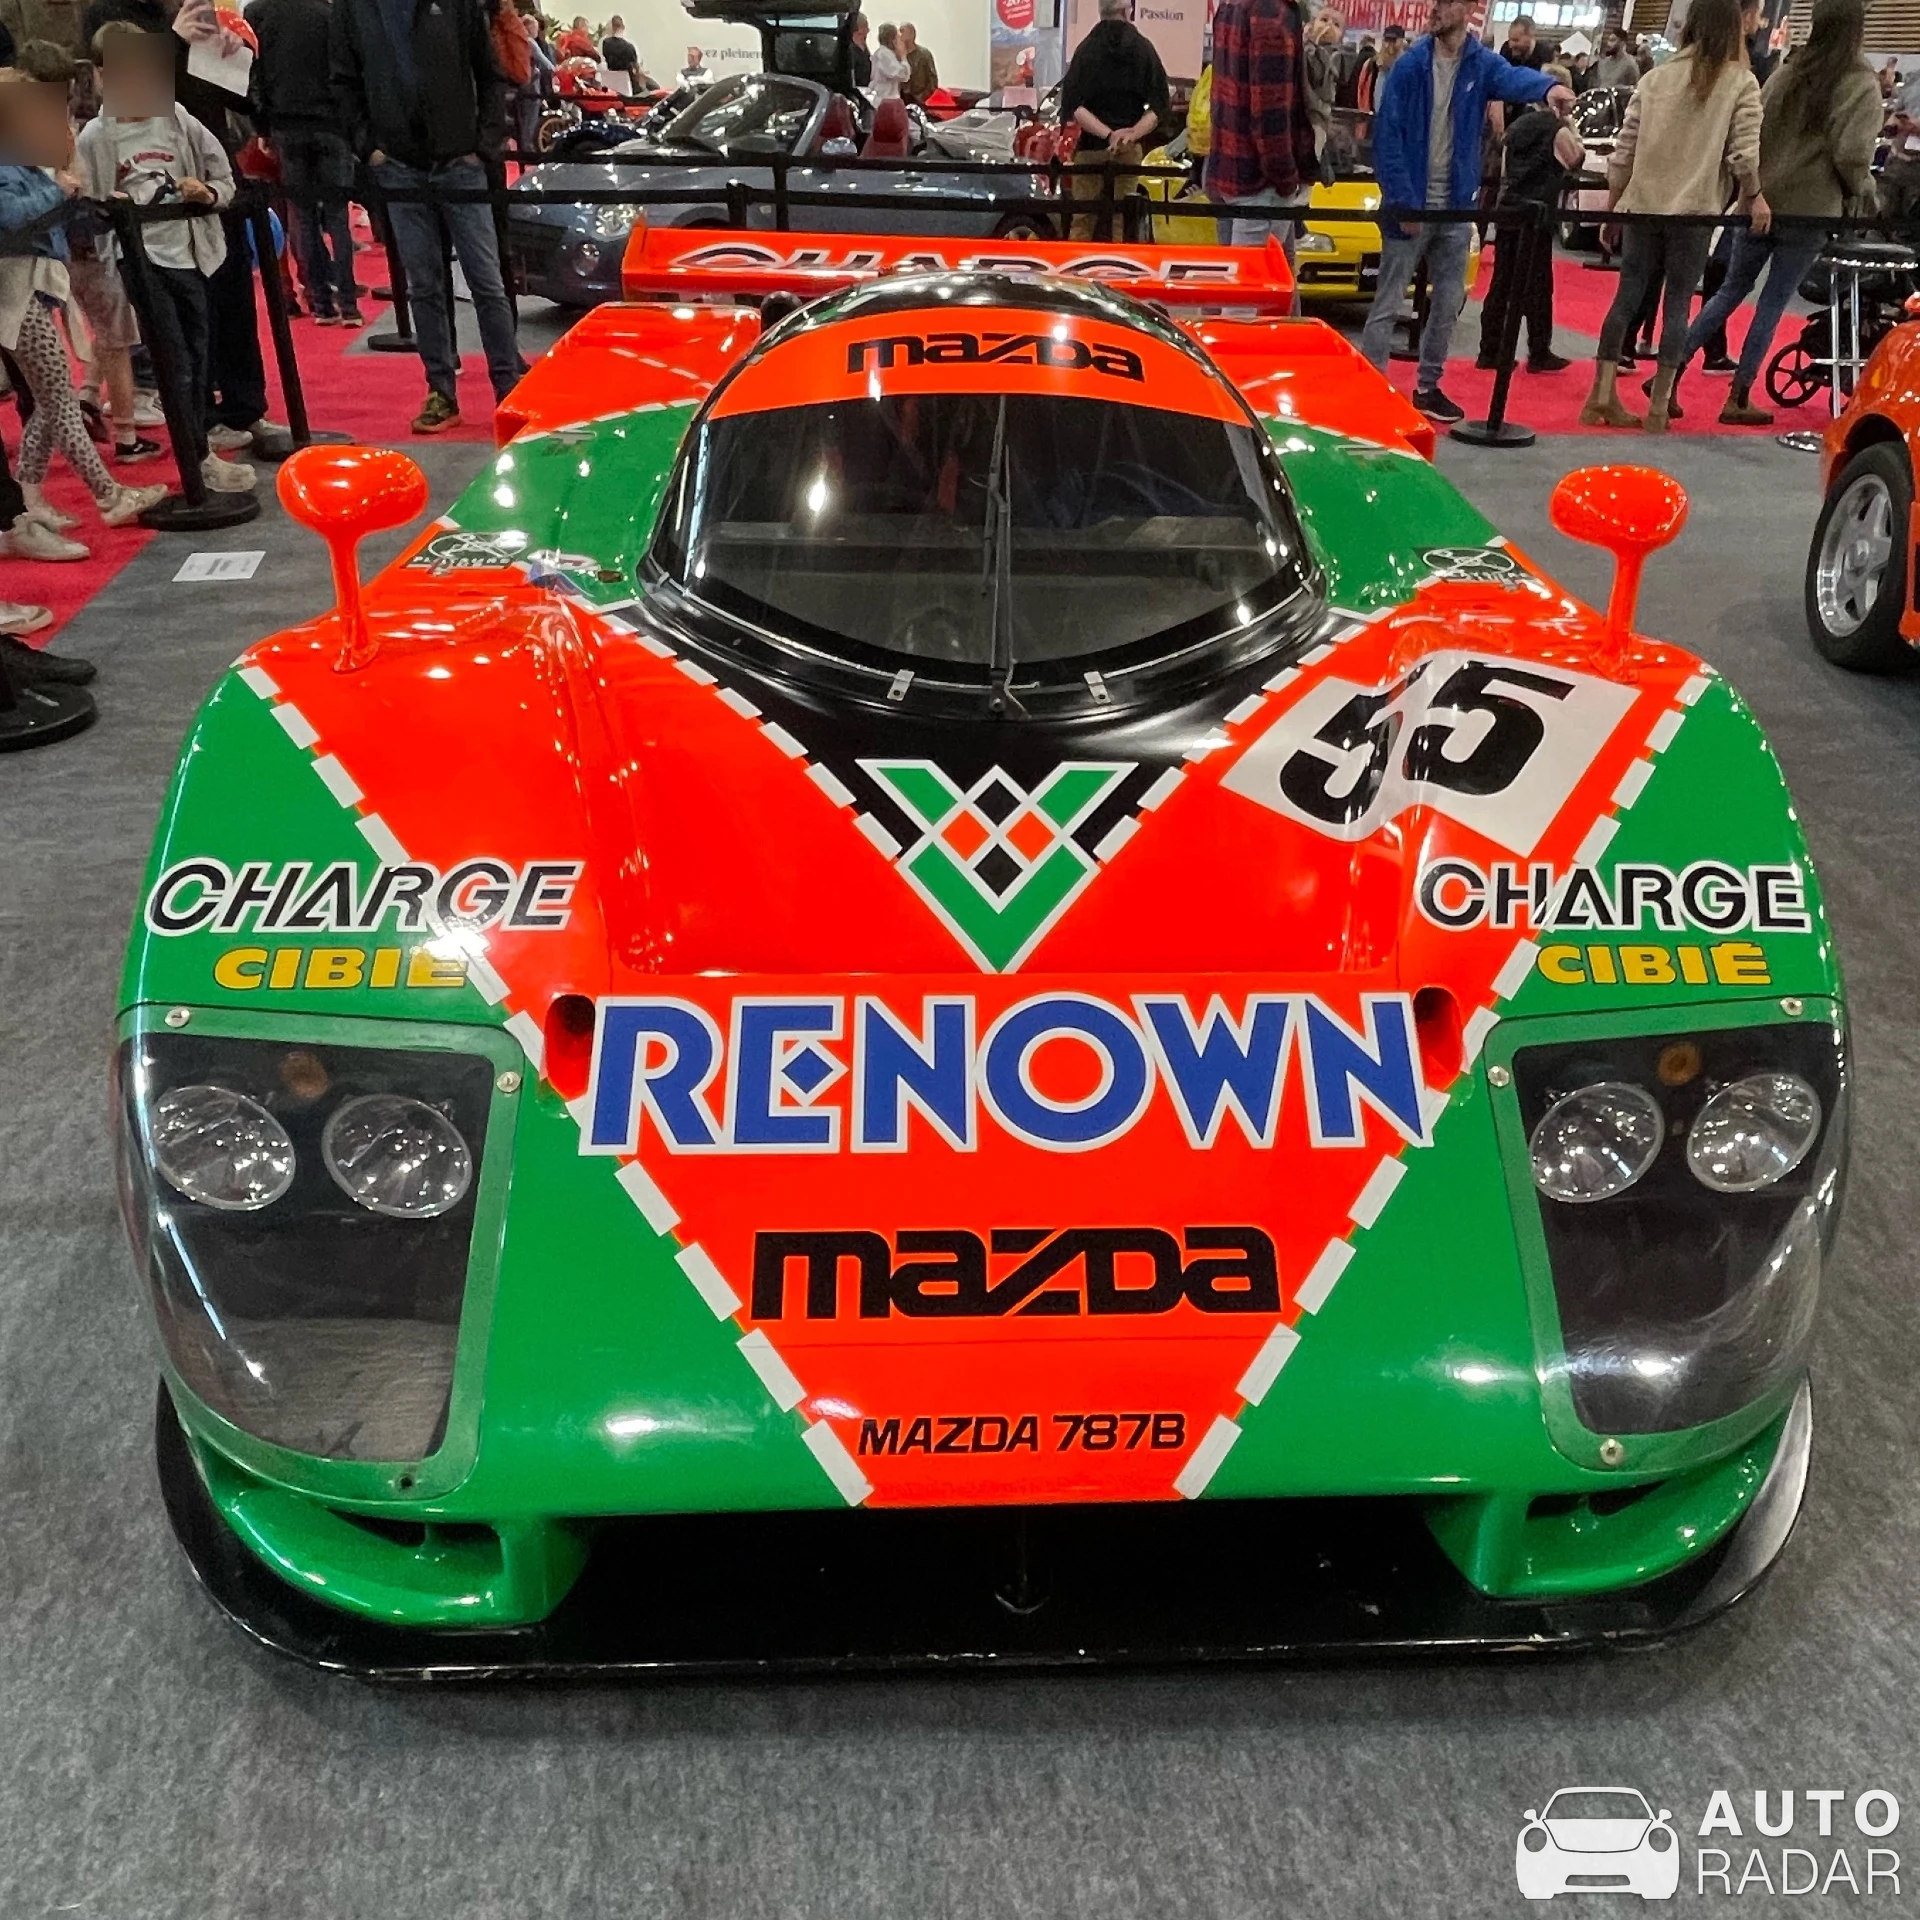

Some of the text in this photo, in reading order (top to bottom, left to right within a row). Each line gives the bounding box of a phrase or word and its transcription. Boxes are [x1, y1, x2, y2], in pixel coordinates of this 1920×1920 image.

[1140, 7, 1184, 21] Passion
[1280, 660, 1576, 824] 55
[145, 857, 585, 937] CHARGE
[1415, 860, 1812, 935] CHARGE
[1536, 941, 1772, 986] CIBIÉ
[578, 991, 1434, 1156] RENOWN
[858, 1413, 1186, 1456] MAZDA 787B
